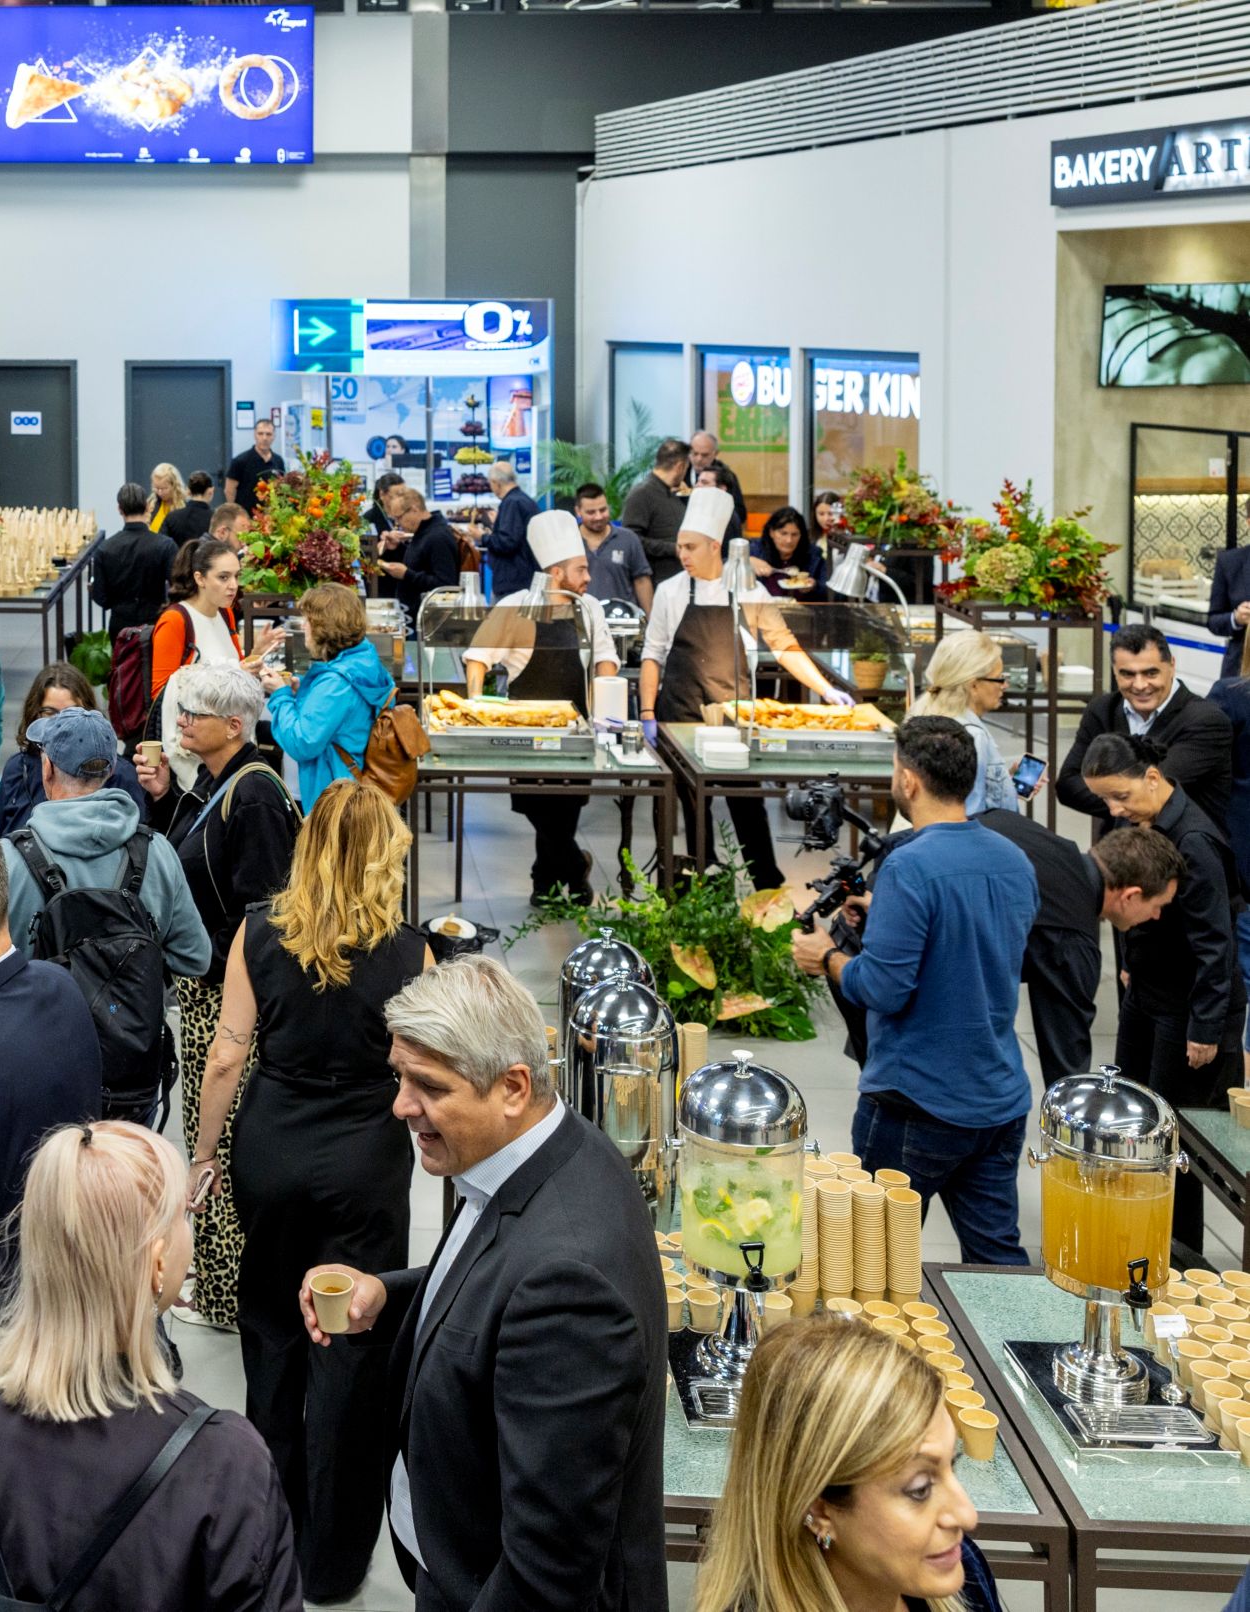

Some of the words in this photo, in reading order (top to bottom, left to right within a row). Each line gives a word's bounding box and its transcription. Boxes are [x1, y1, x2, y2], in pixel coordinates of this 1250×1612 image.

[1053, 145, 1158, 189] BAKERY
[1165, 137, 1250, 177] ART
[463, 301, 534, 343] 0%
[868, 371, 920, 419] KIN
